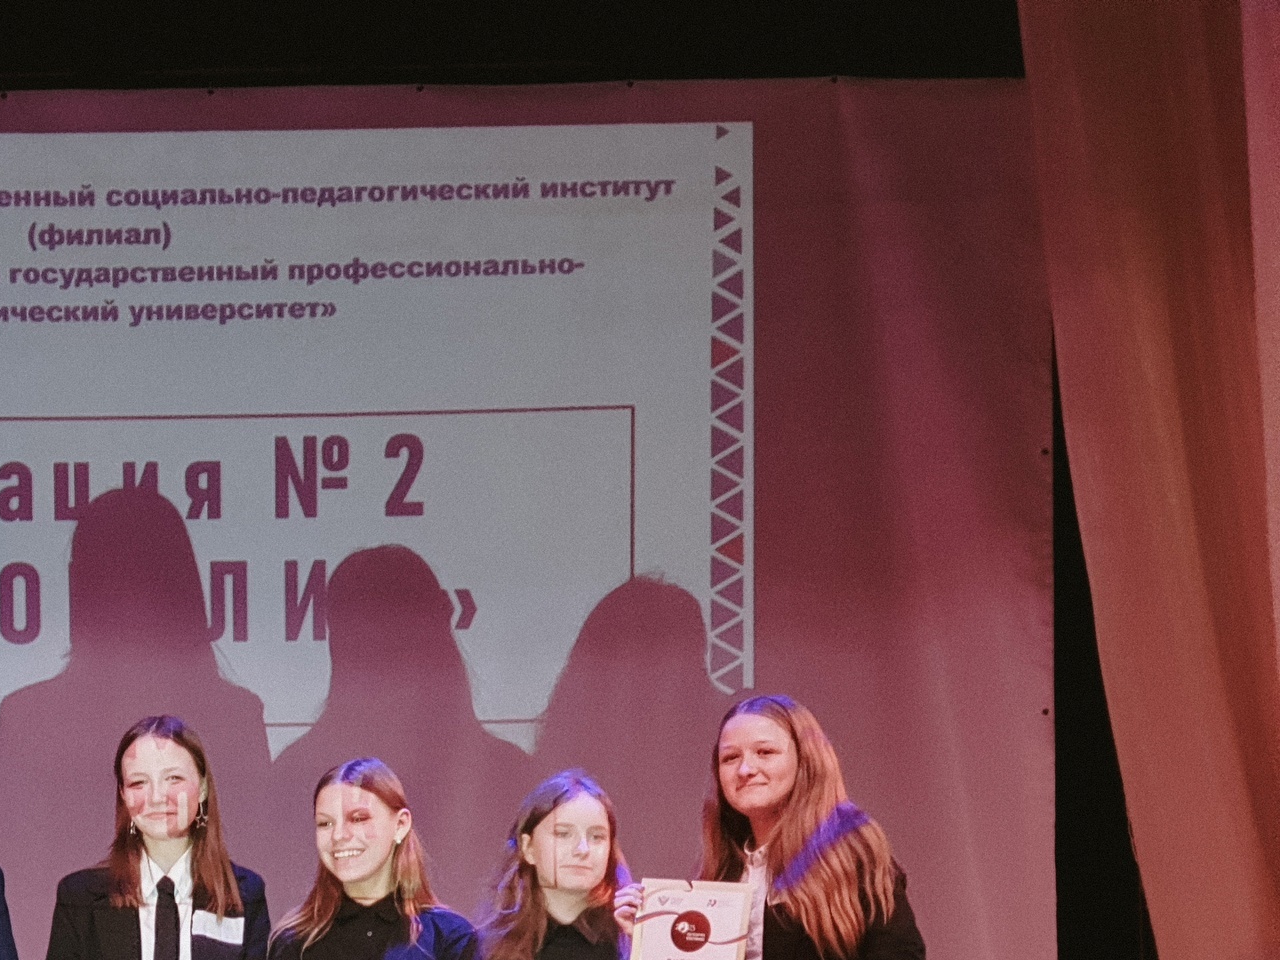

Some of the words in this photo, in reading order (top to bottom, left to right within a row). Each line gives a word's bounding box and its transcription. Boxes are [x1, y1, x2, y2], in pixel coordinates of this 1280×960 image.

[105, 176, 530, 210] социально-педагогический
[540, 178, 676, 204] институт
[27, 221, 173, 253] (филиал)
[9, 258, 279, 292] государственный
[287, 256, 586, 287] профессионально-
[128, 300, 337, 329] университет»
[273, 434, 350, 519] №
[384, 432, 426, 517] 2
